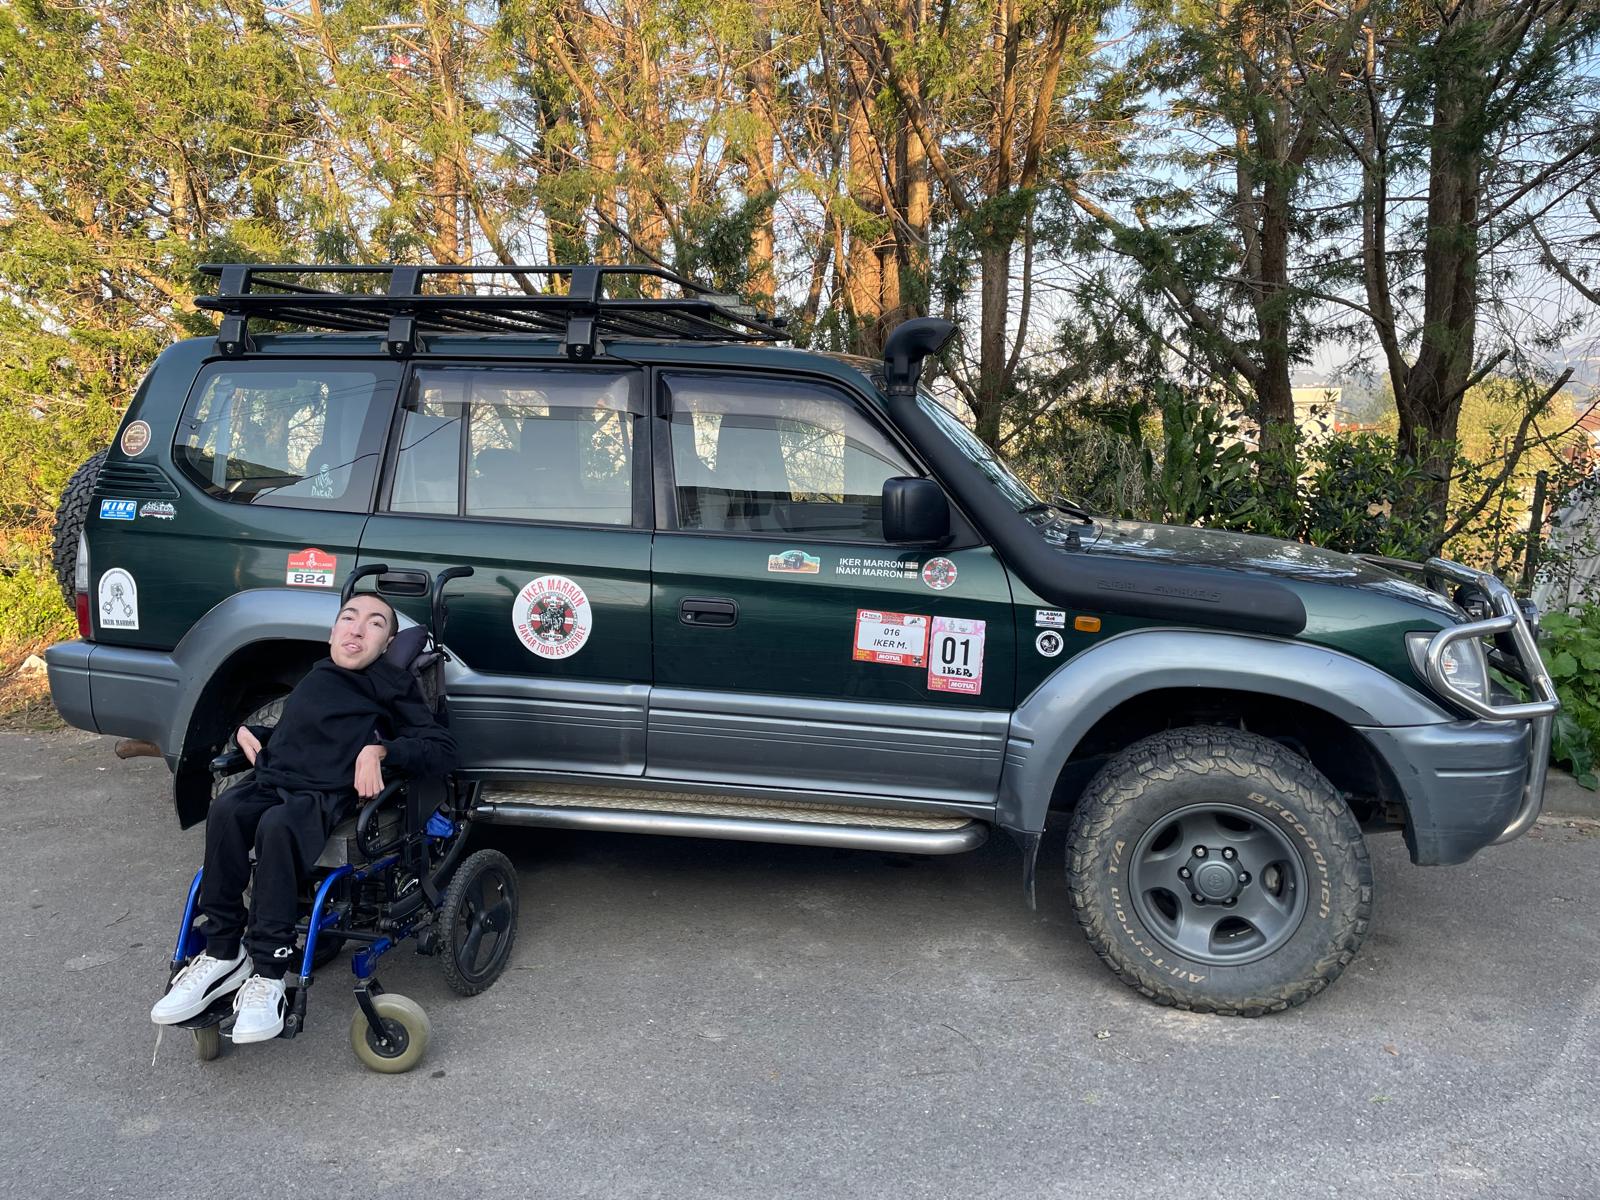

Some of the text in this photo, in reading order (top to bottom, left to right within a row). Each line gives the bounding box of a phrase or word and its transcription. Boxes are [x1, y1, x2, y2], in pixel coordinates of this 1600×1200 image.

[103, 502, 135, 511] KING
[839, 558, 904, 569] IKER MARRON
[836, 566, 903, 578] IÑAKI MARRON
[294, 574, 326, 584] 824
[522, 579, 586, 608] IKER MARRÓN
[884, 628, 901, 636] 016
[518, 623, 587, 656] DAKAR TODO ES POSIBLE
[873, 638, 908, 650] IKER M.
[942, 636, 970, 666] 01
[950, 681, 975, 690] MOTUL
[1108, 840, 1126, 874] T/A
[1248, 792, 1331, 919] BFGoodrich
